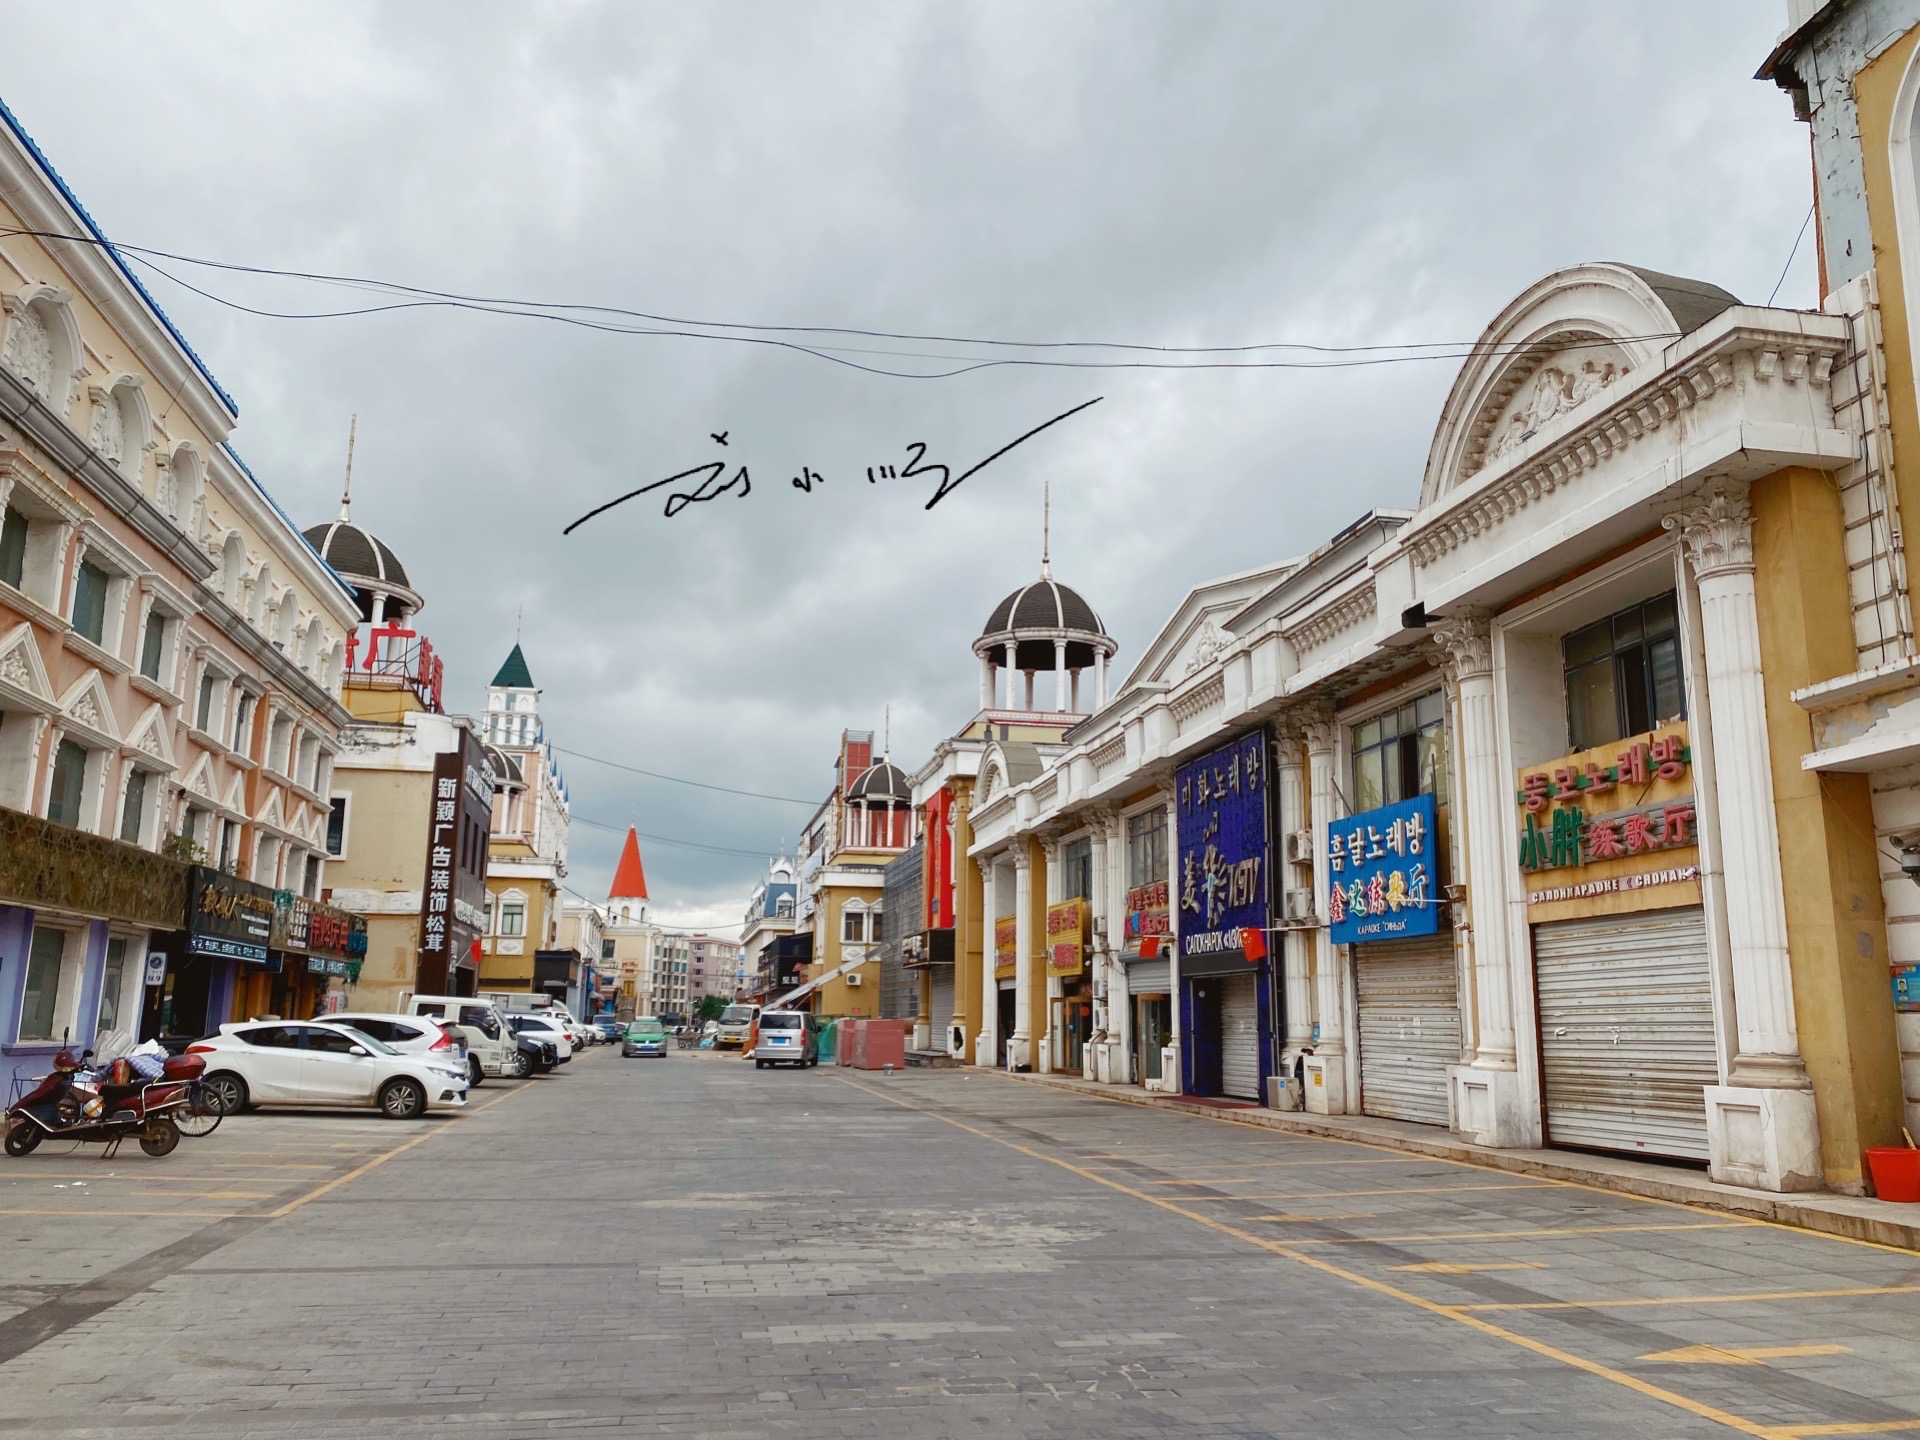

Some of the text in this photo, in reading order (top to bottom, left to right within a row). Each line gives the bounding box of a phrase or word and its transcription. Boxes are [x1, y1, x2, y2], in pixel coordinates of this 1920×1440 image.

[1523, 735, 1686, 812] 뚱보노래방
[424, 777, 457, 953] 新颖广告装饰松茸
[1519, 804, 1695, 870] 小胖练歌厅
[1330, 863, 1429, 924] 鑫达练歌厅
